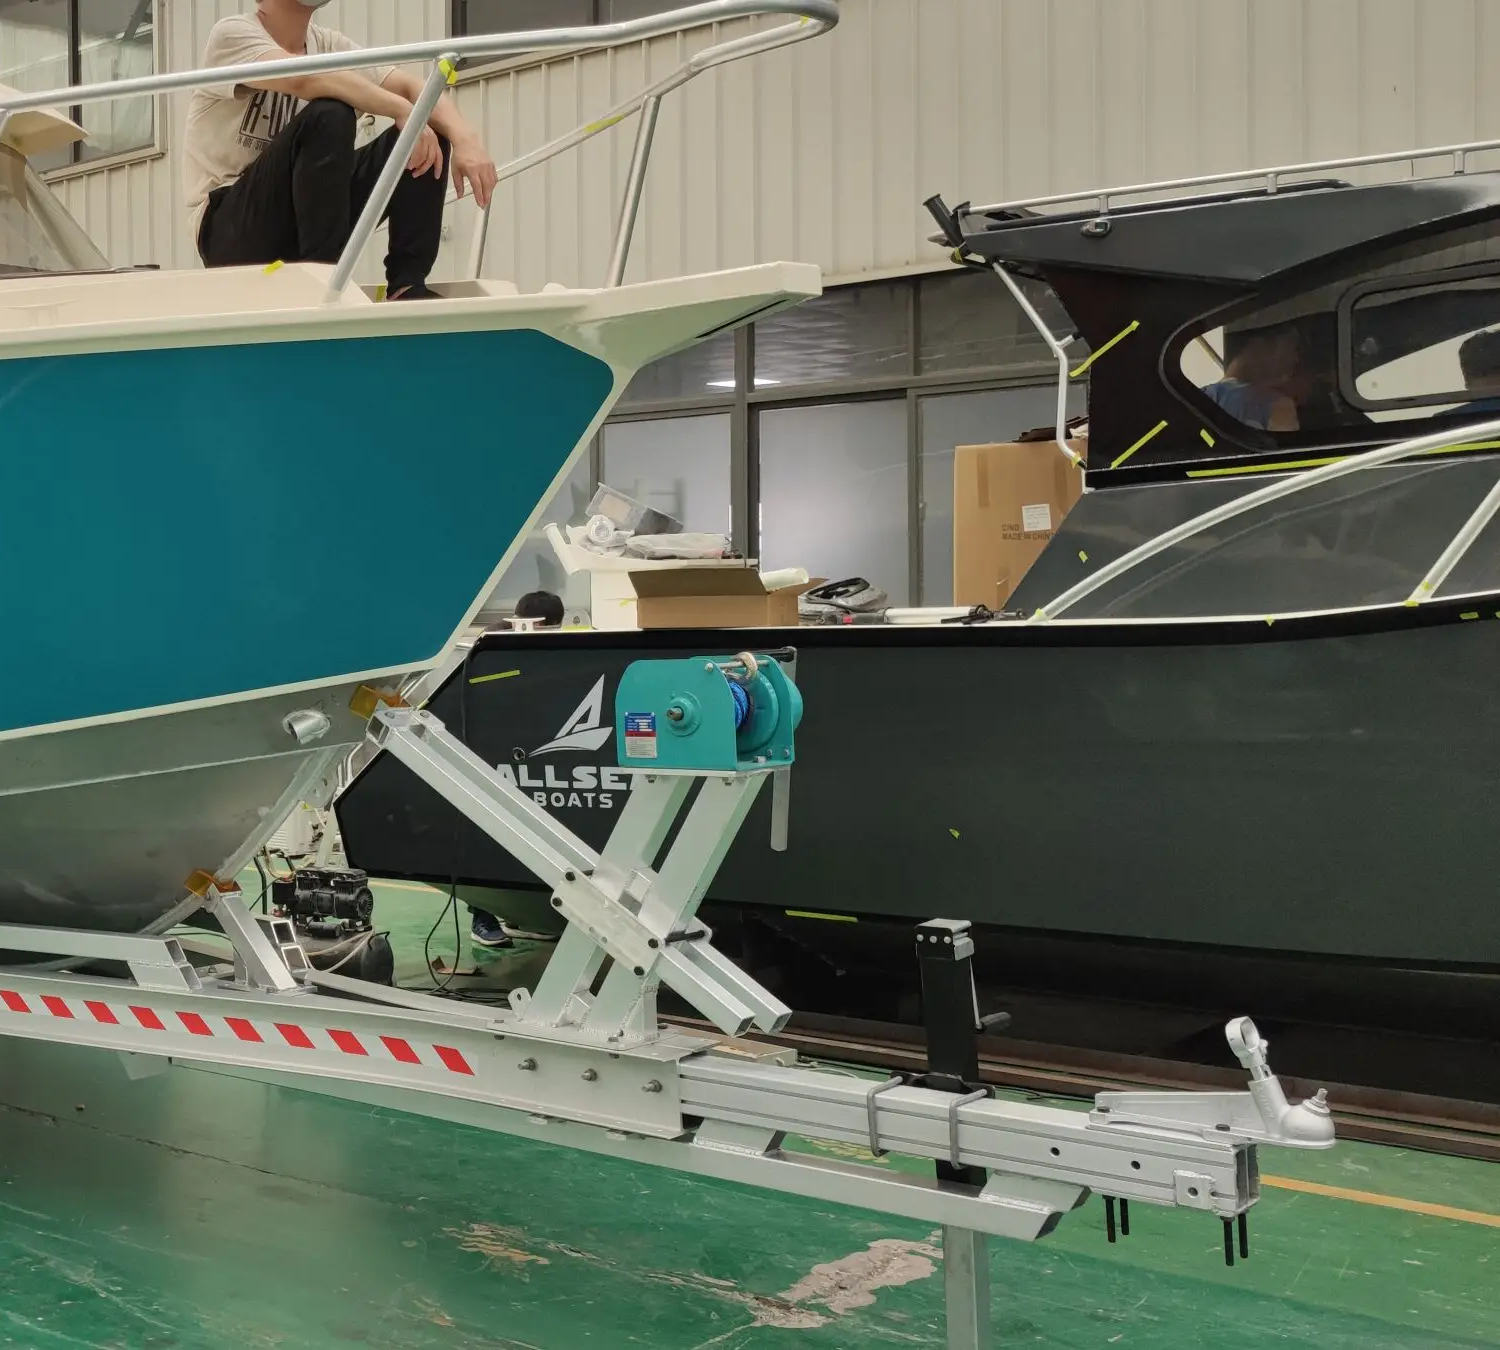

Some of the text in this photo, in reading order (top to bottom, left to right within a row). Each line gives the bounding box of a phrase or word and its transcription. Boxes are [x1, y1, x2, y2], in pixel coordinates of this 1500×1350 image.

[1001, 531, 1022, 541] MADE
[1032, 531, 1055, 541] CHIN
[496, 763, 637, 791] ALLSE
[533, 791, 614, 809] BOATS
